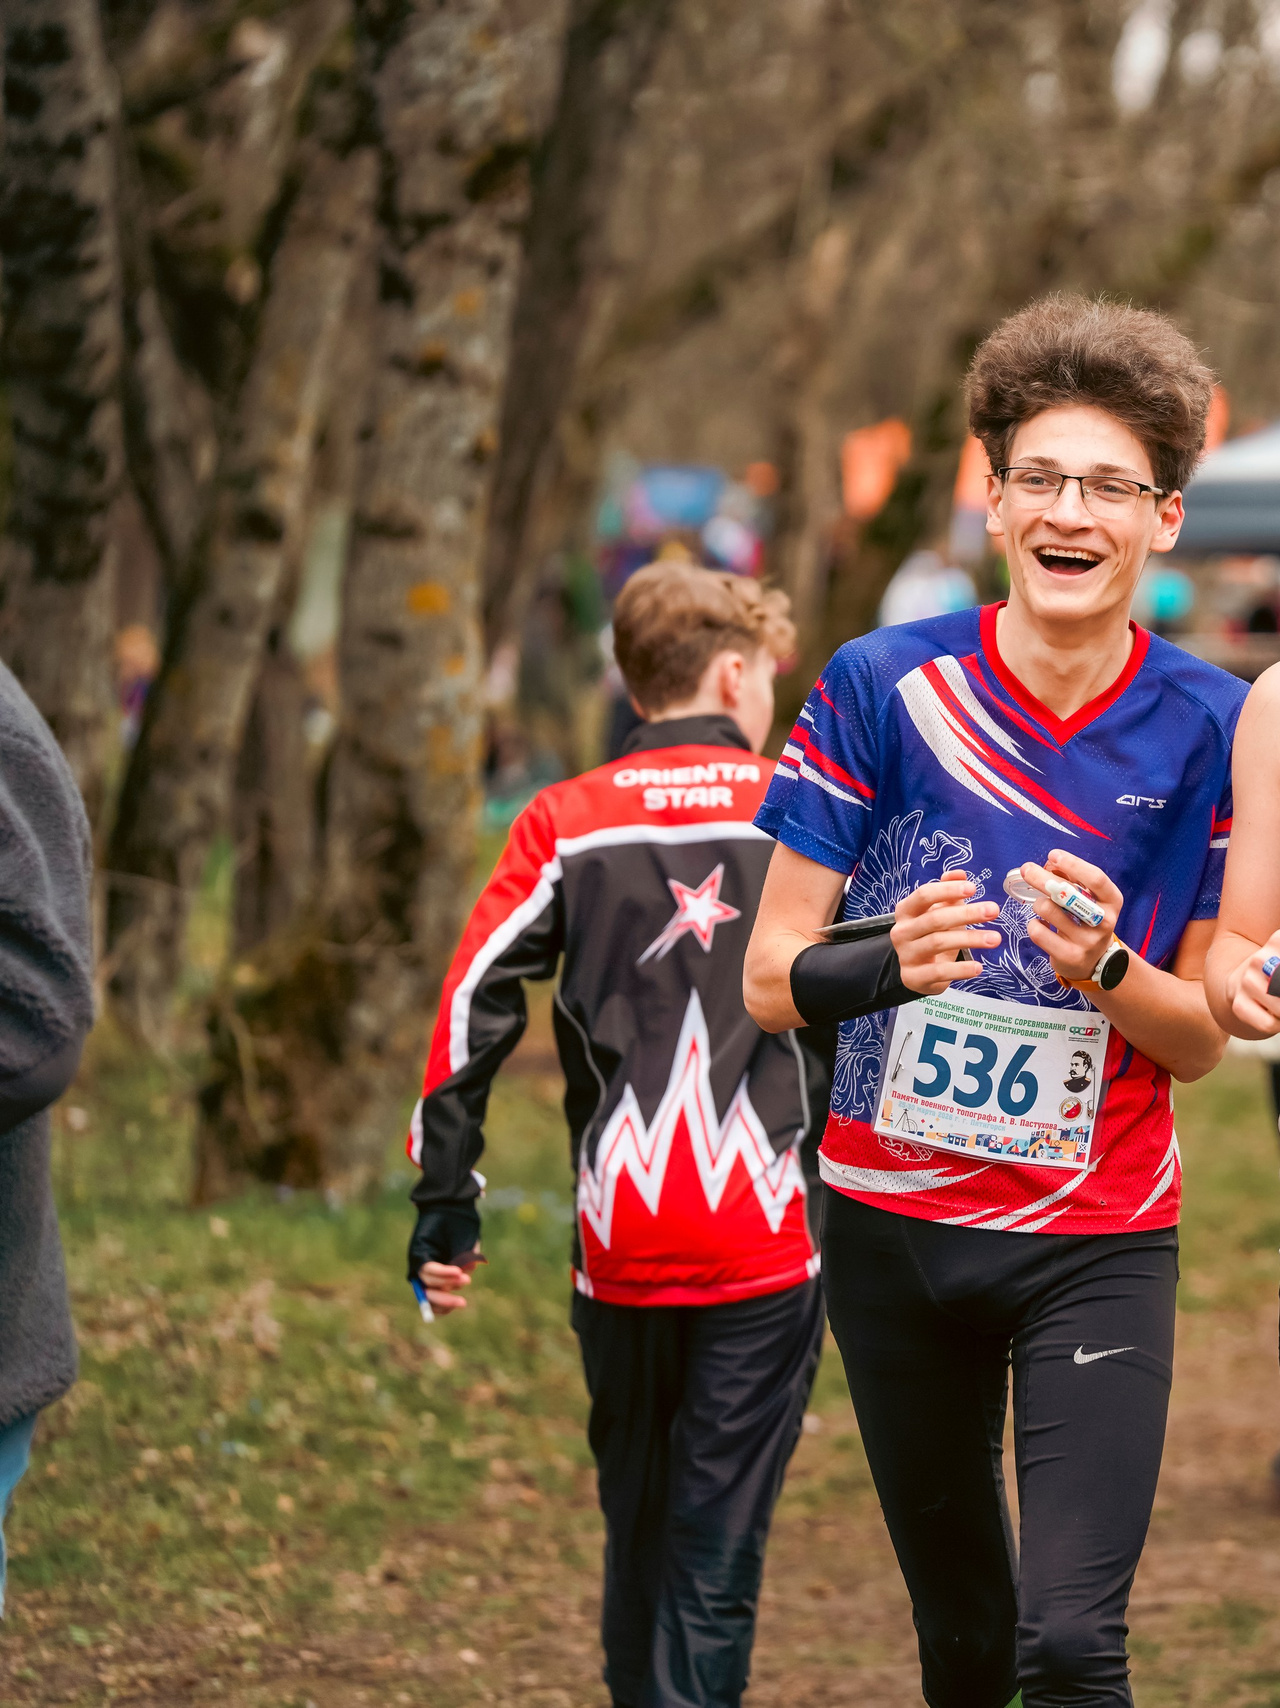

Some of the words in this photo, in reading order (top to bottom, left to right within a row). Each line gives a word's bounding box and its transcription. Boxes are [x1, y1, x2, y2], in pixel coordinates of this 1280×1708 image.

[613, 762, 760, 788] ORIENTA
[643, 786, 734, 811] STAR
[916, 997, 964, 1013] ЕРОССИЙСКИЕ
[966, 1008, 1013, 1024] СПОРТИВНЫЕ
[1015, 1018, 1067, 1031] СОРЕВНОВАНИЯ
[924, 1007, 933, 1016] ПО
[935, 1010, 983, 1028] СПОРТИВНОМУ
[984, 1022, 1049, 1039] ОРИЕНТИРОВАНИЮ
[913, 1023, 1039, 1116] 536
[891, 1090, 919, 1104] Памяти
[920, 1099, 955, 1113] военного
[956, 1108, 997, 1123] топографа
[999, 1116, 1007, 1124] А.
[1009, 1117, 1017, 1126] В.
[1019, 1118, 1058, 1131] Пастухова
